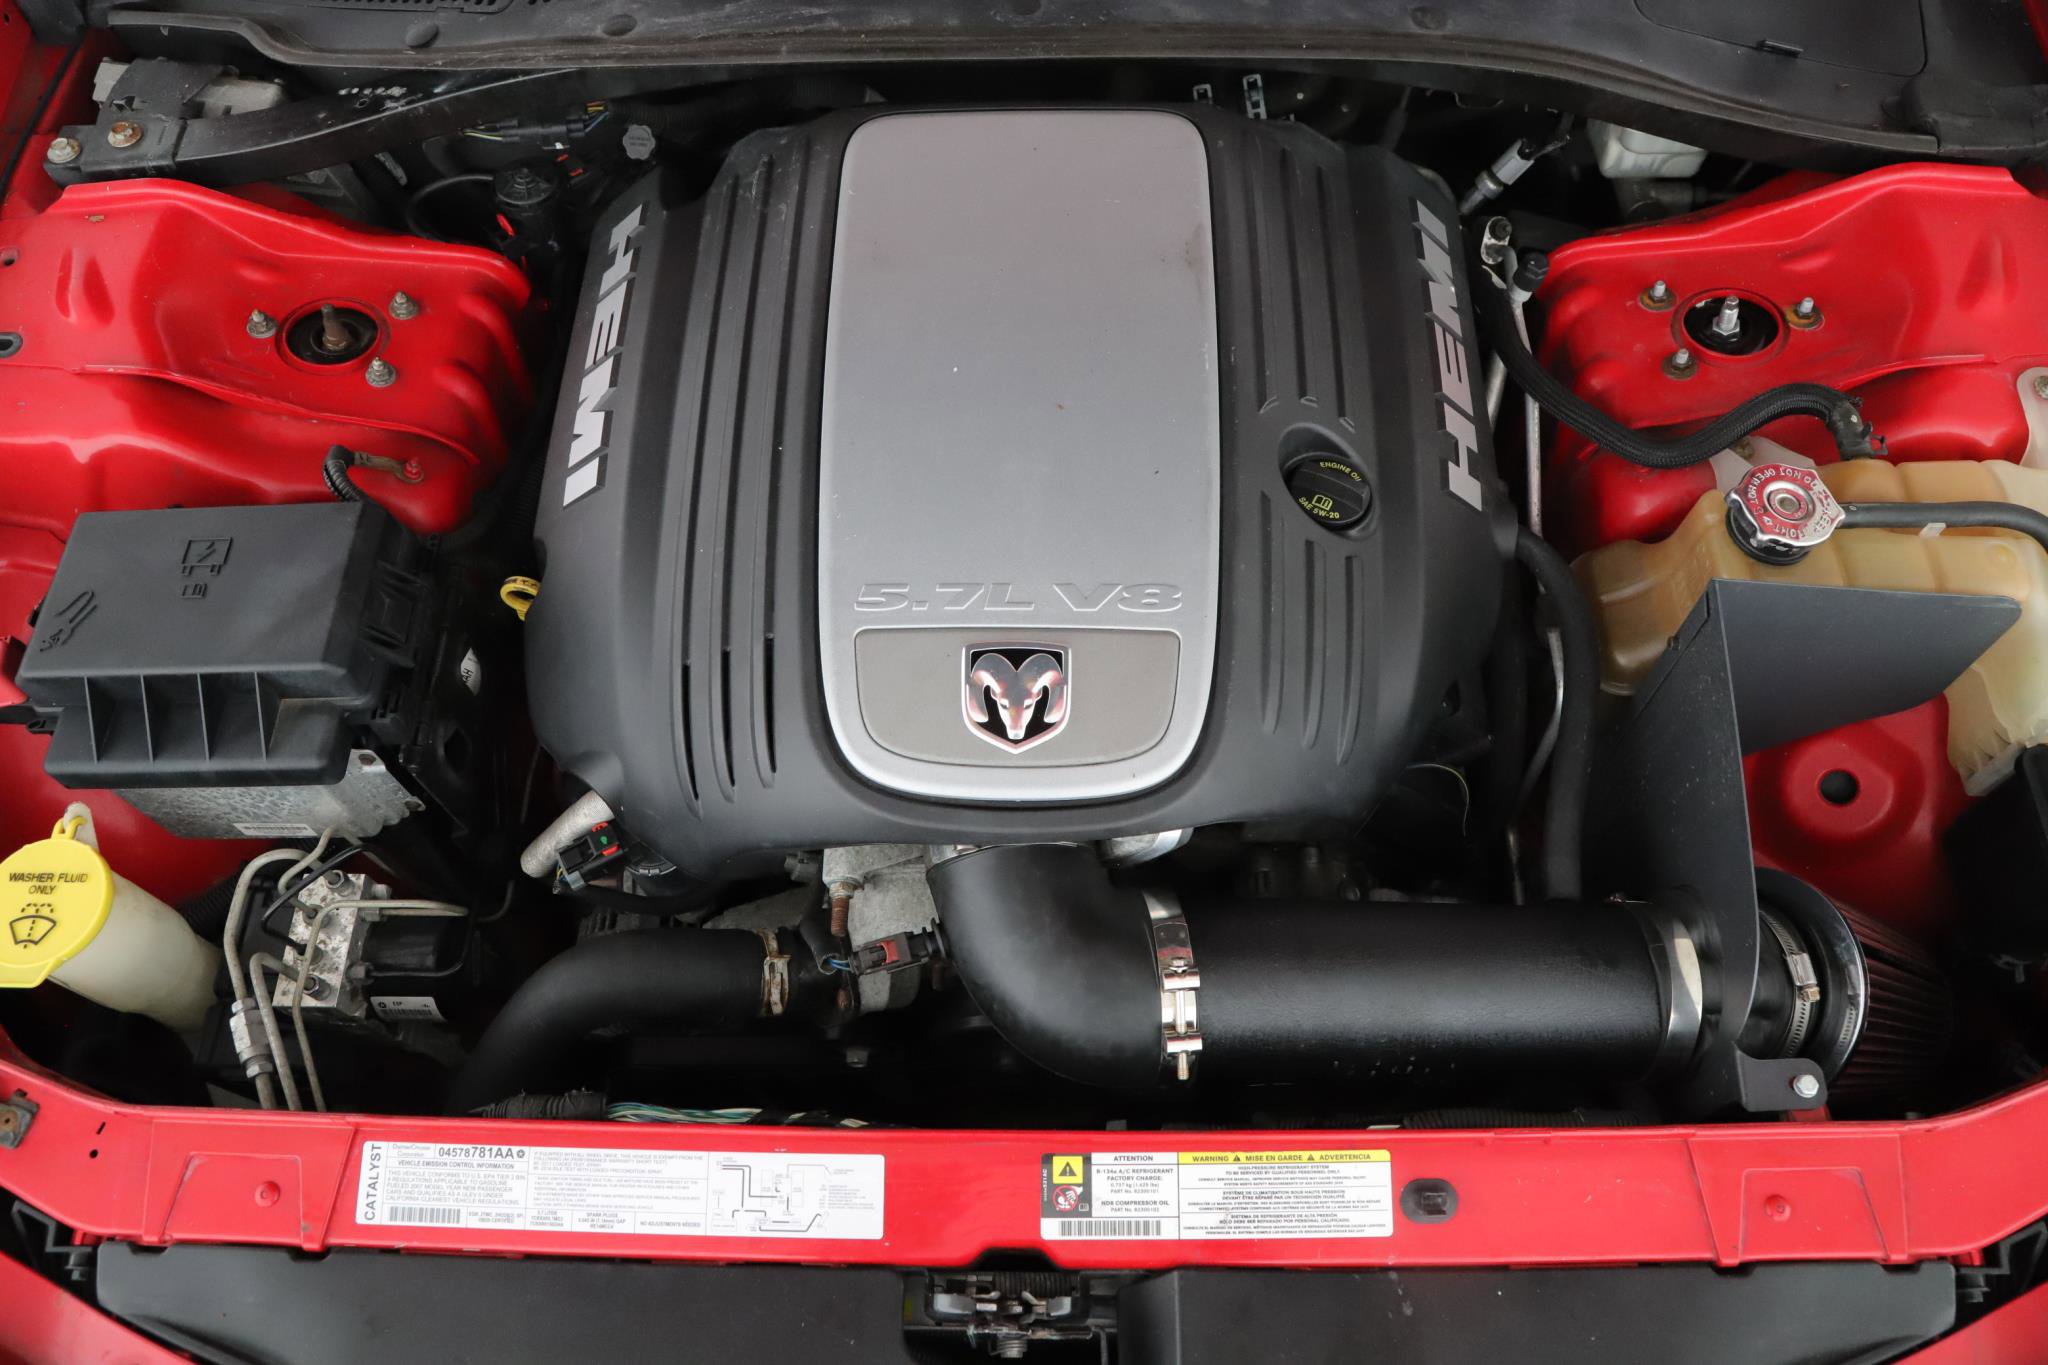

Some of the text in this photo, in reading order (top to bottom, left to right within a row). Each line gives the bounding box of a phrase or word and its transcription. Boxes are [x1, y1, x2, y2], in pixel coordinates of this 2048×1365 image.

[563, 205, 643, 507] HEMI
[1417, 199, 1482, 512] HEMI
[1320, 461, 1352, 473] ENGINE
[1779, 467, 1802, 480] NOT
[1752, 468, 1776, 486] OPEN
[1298, 496, 1340, 519] SAE 5W-20
[854, 582, 1183, 612] 5.7L V8
[9, 872, 88, 883] WASHER FLUID
[28, 885, 56, 895] ONLY
[438, 1146, 515, 1159] 04578781AA
[364, 1144, 382, 1222] CATALYST
